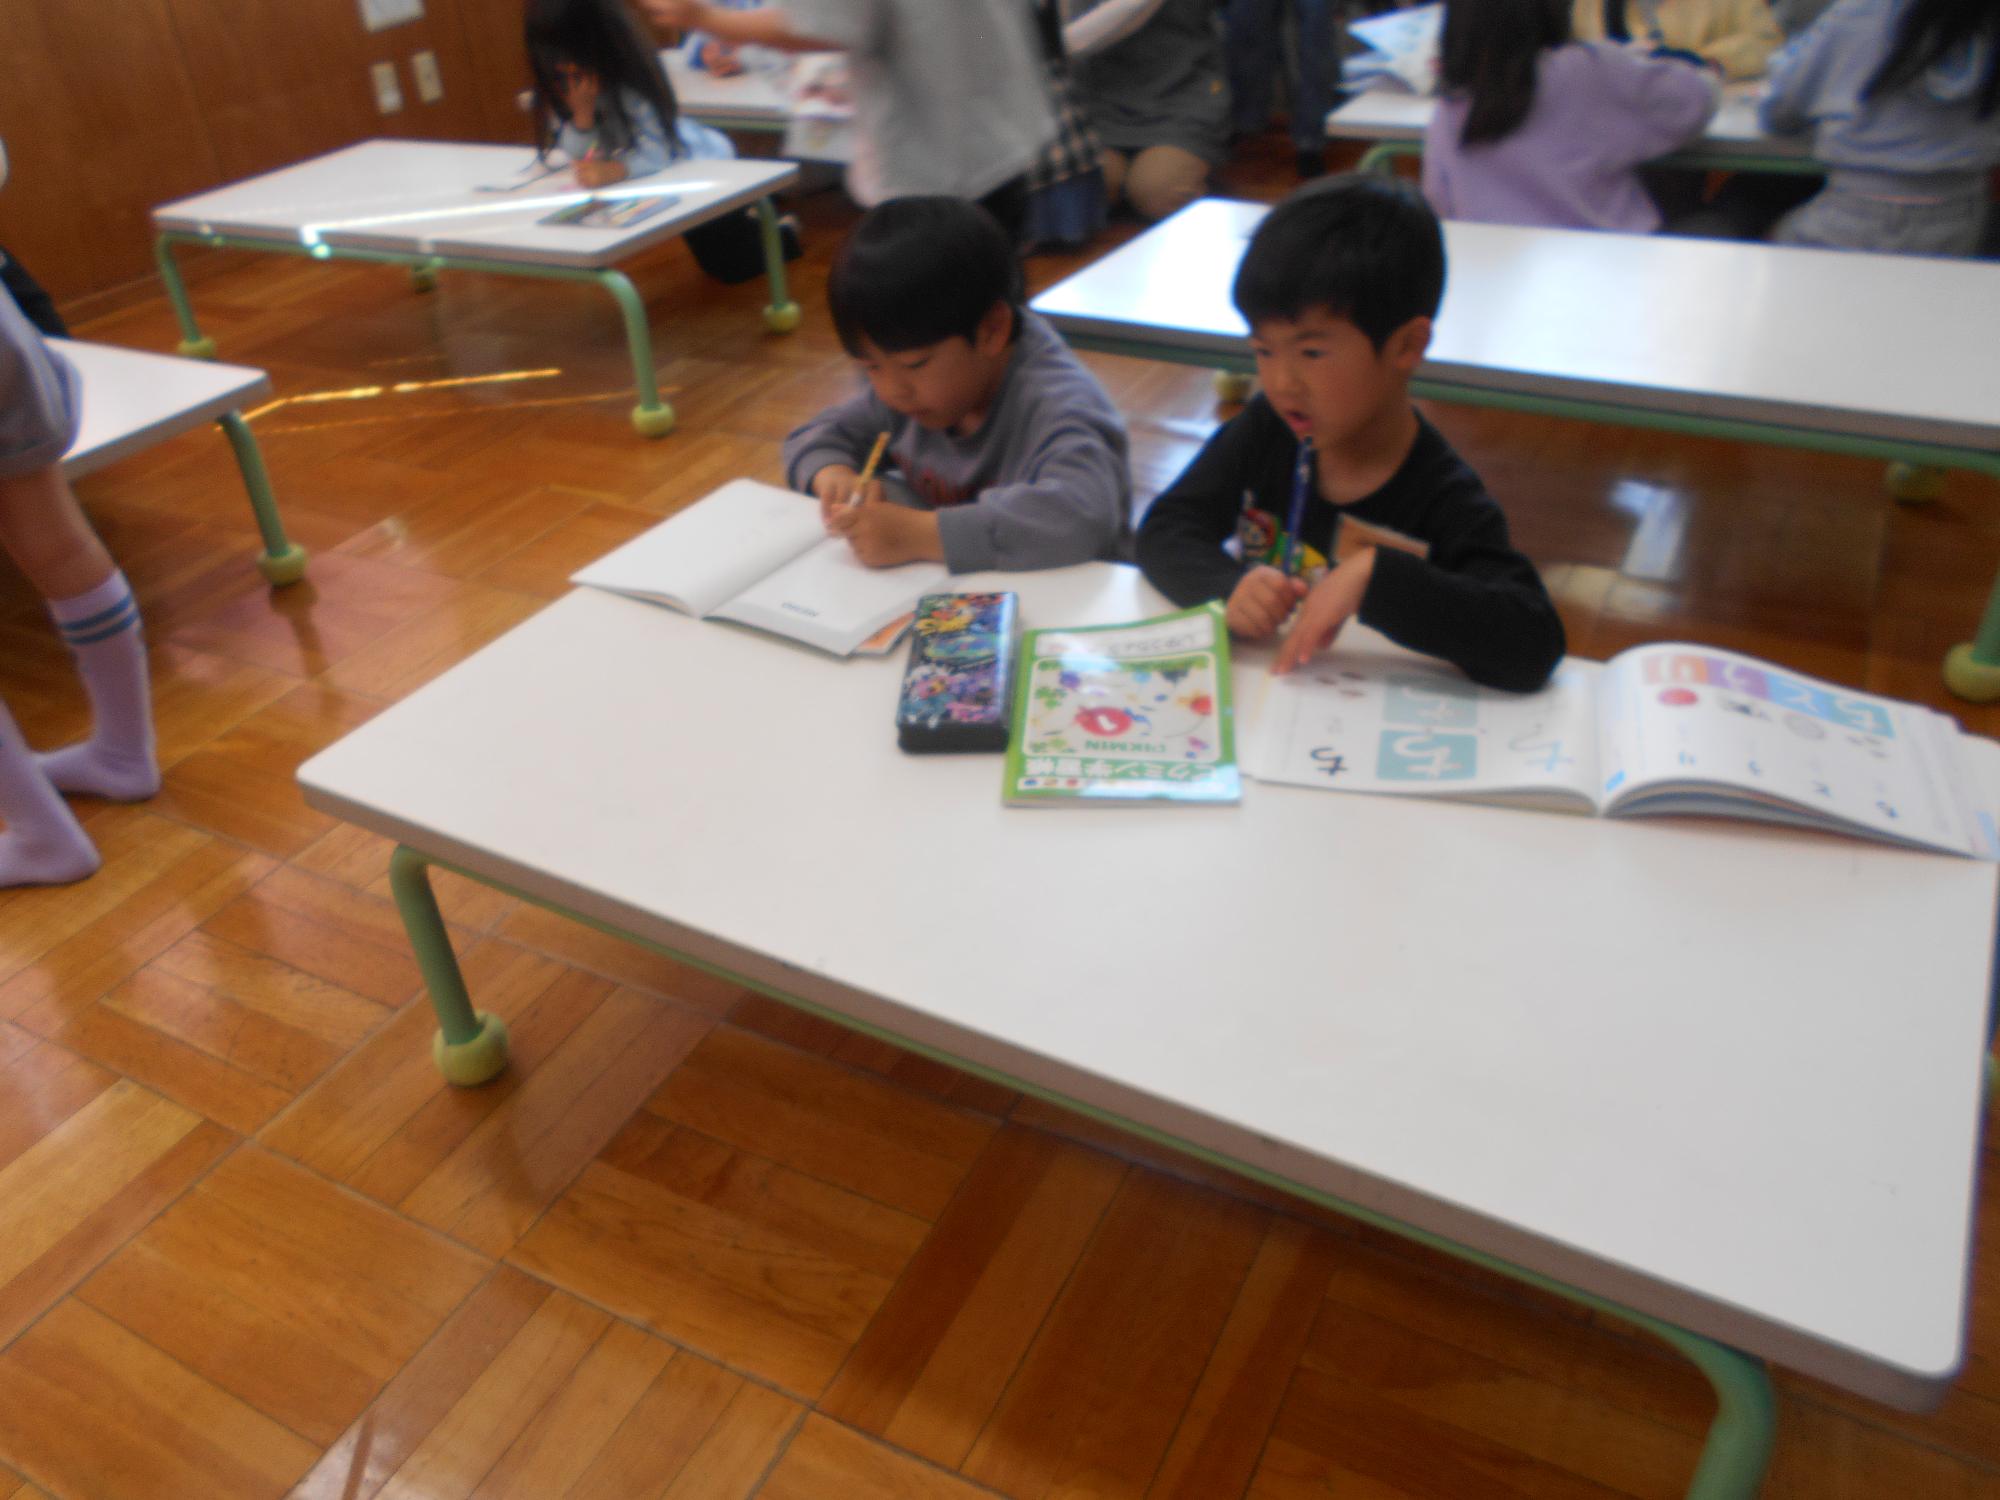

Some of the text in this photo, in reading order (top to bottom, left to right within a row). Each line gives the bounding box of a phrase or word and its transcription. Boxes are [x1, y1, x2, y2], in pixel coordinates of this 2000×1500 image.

[1834, 694, 1885, 735] ち
[1310, 747, 1348, 777] ち
[1391, 733, 1462, 777] ち
